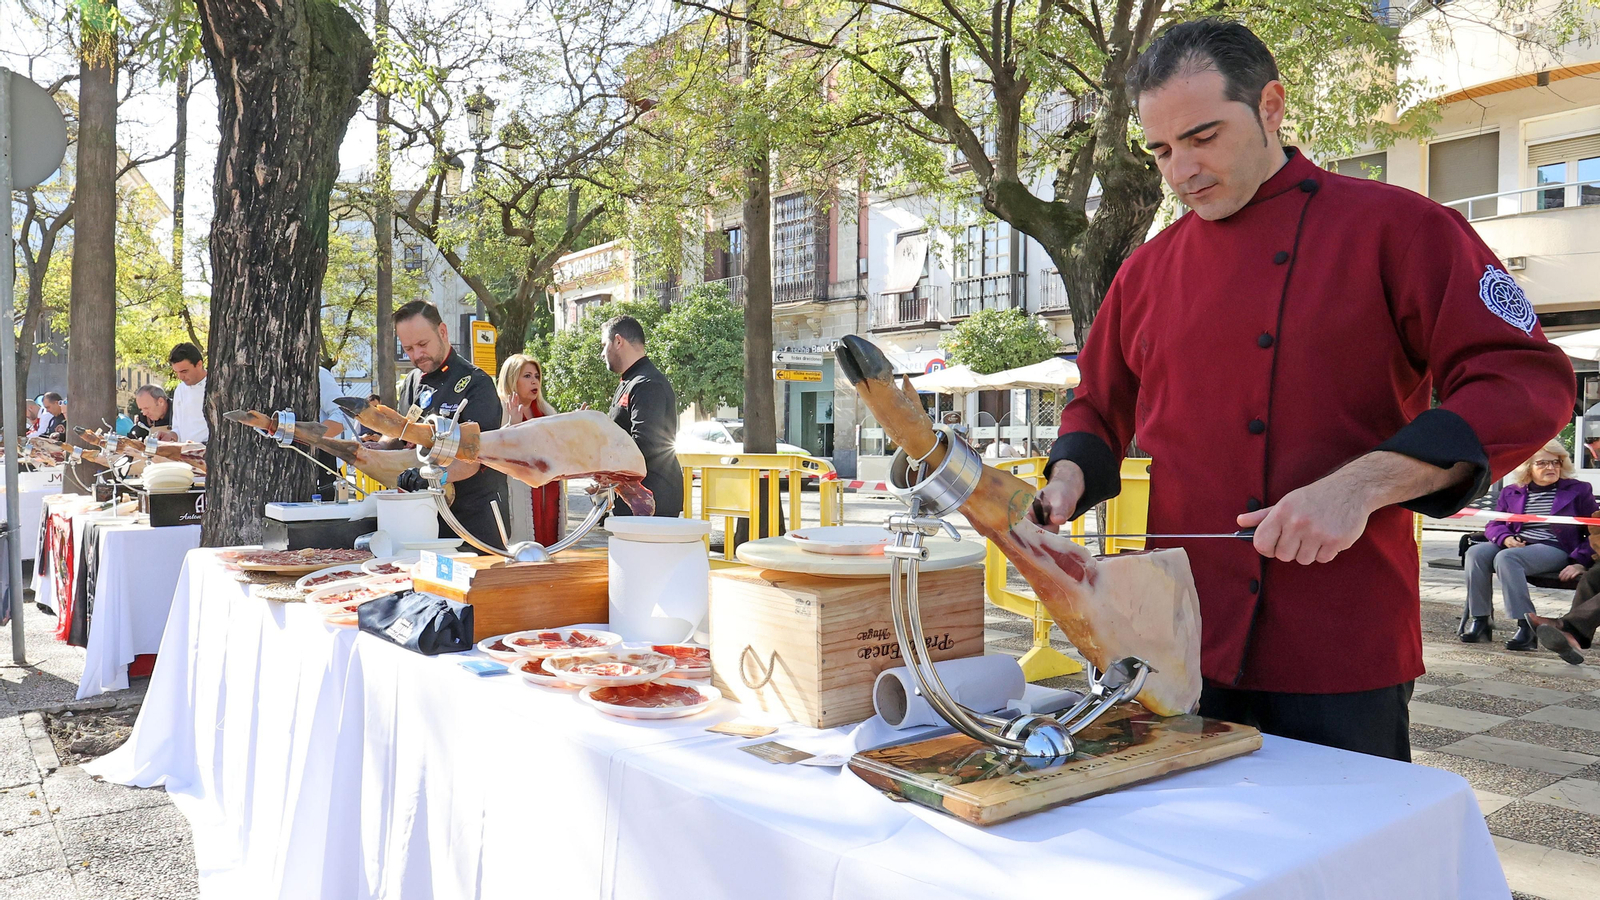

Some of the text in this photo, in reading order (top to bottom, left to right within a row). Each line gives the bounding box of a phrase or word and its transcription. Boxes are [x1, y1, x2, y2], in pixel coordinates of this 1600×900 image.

[811, 344, 831, 353] Bank
[933, 364, 940, 373] P
[48, 473, 62, 483] JM
[179, 512, 202, 521] Anton
[856, 628, 891, 641] Muga
[857, 633, 955, 660] Prao Enea
